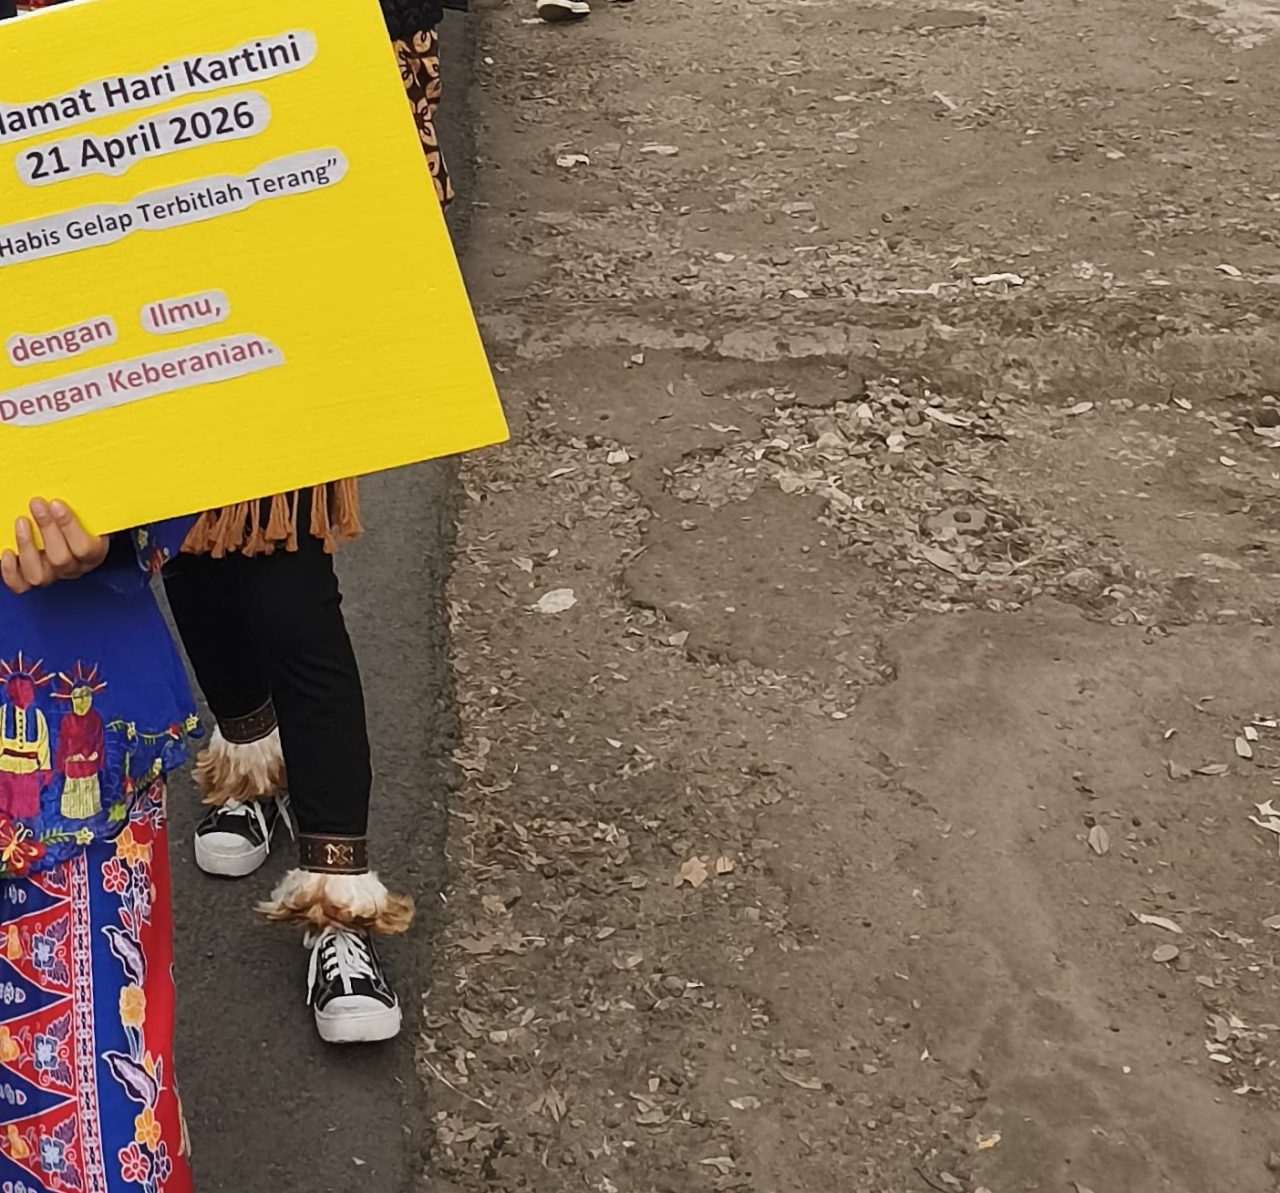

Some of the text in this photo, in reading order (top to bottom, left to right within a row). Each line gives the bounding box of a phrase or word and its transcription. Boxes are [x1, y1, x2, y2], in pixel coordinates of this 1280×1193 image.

[102, 65, 176, 108] Hari
[183, 34, 301, 87] Kartini
[25, 101, 255, 180] 21 April 2026
[66, 211, 134, 240] Gelap
[137, 181, 243, 223] Terbitlah
[247, 158, 338, 197] Terang”
[10, 319, 113, 363] dengan
[150, 295, 222, 329] Ilmu,
[106, 337, 274, 394] Keberanian.
